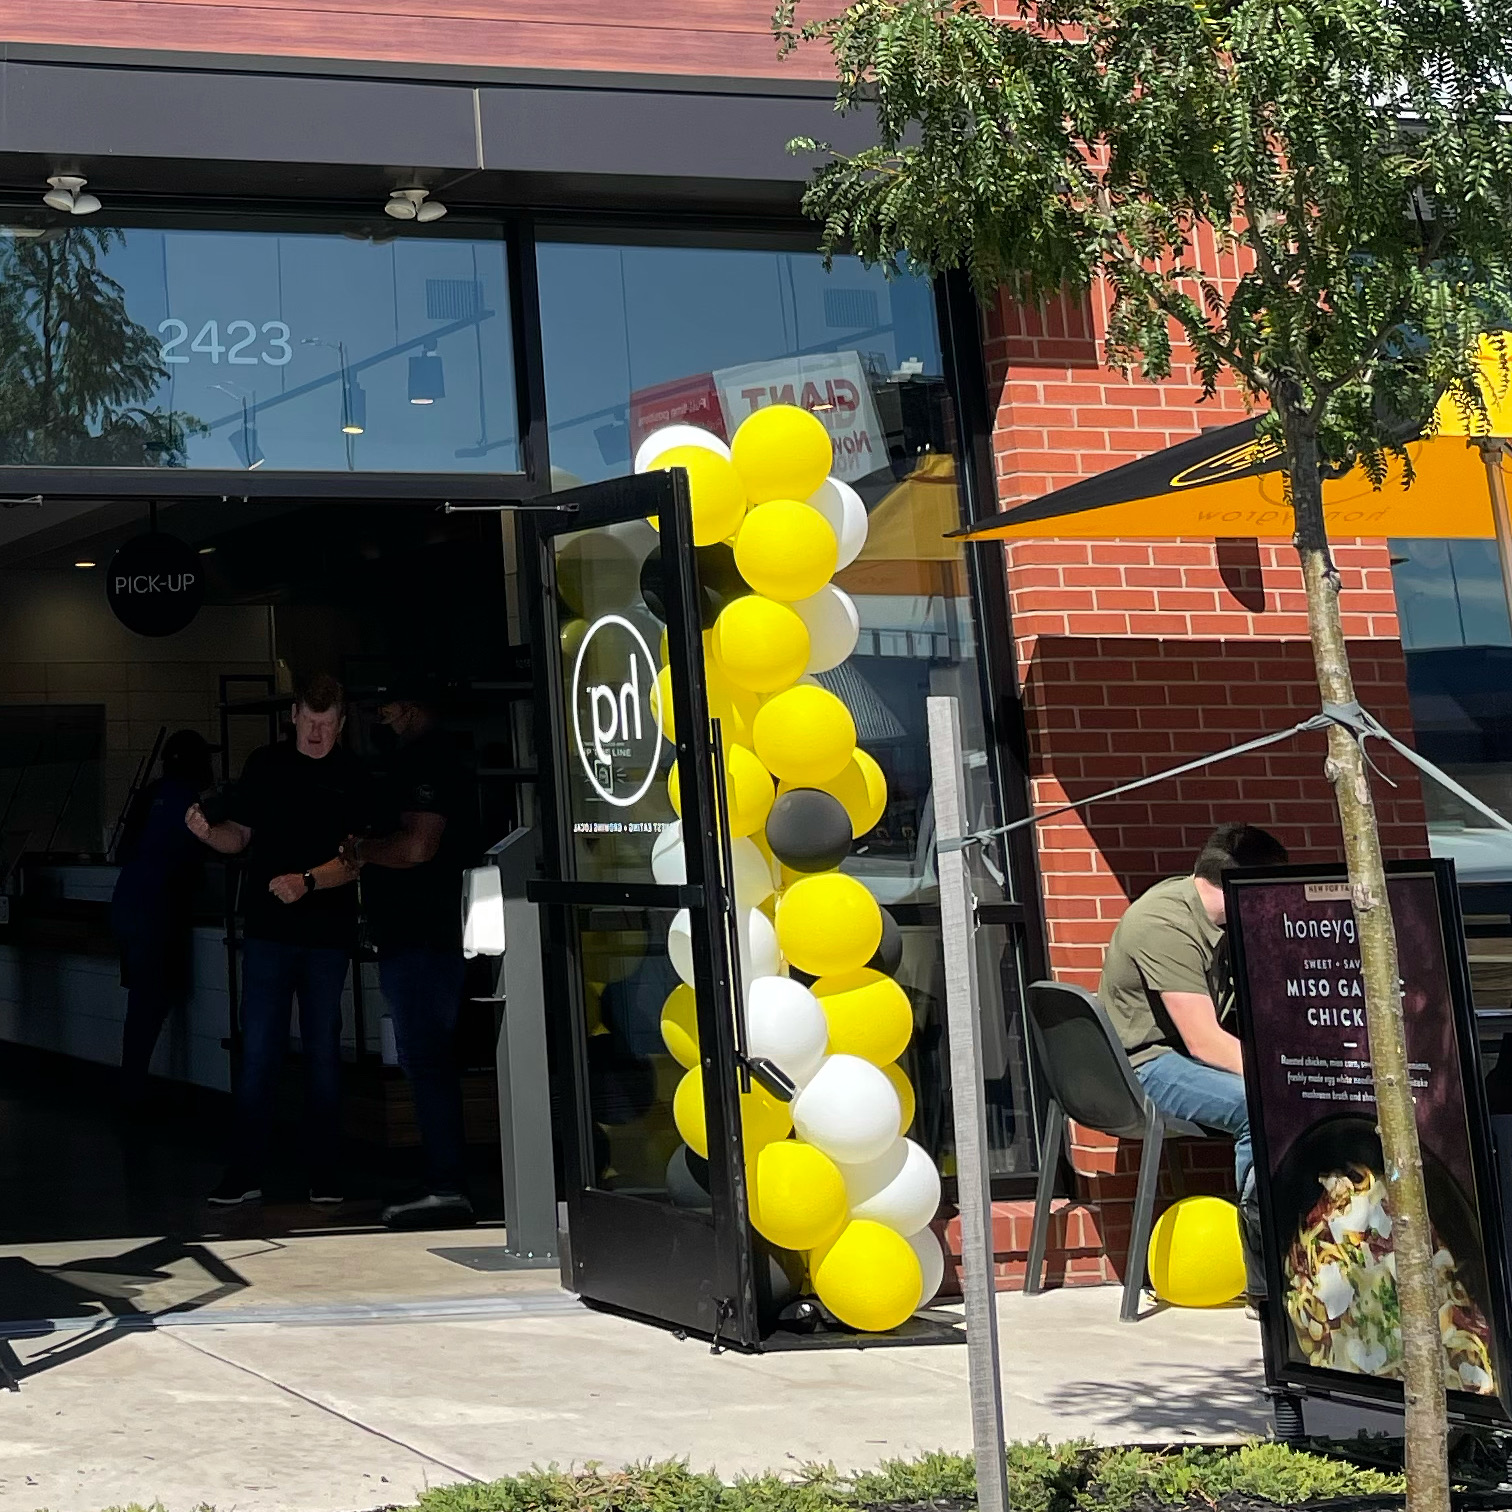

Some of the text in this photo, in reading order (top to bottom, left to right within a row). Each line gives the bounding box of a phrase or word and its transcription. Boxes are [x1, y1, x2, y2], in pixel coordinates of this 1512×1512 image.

[157, 318, 293, 366] 2423
[115, 573, 195, 594] PICK-UP
[1283, 912, 1355, 944] honeyg
[1303, 959, 1332, 970] SWEET
[1287, 978, 1330, 997] MISO
[1307, 1008, 1364, 1027] CHICK
